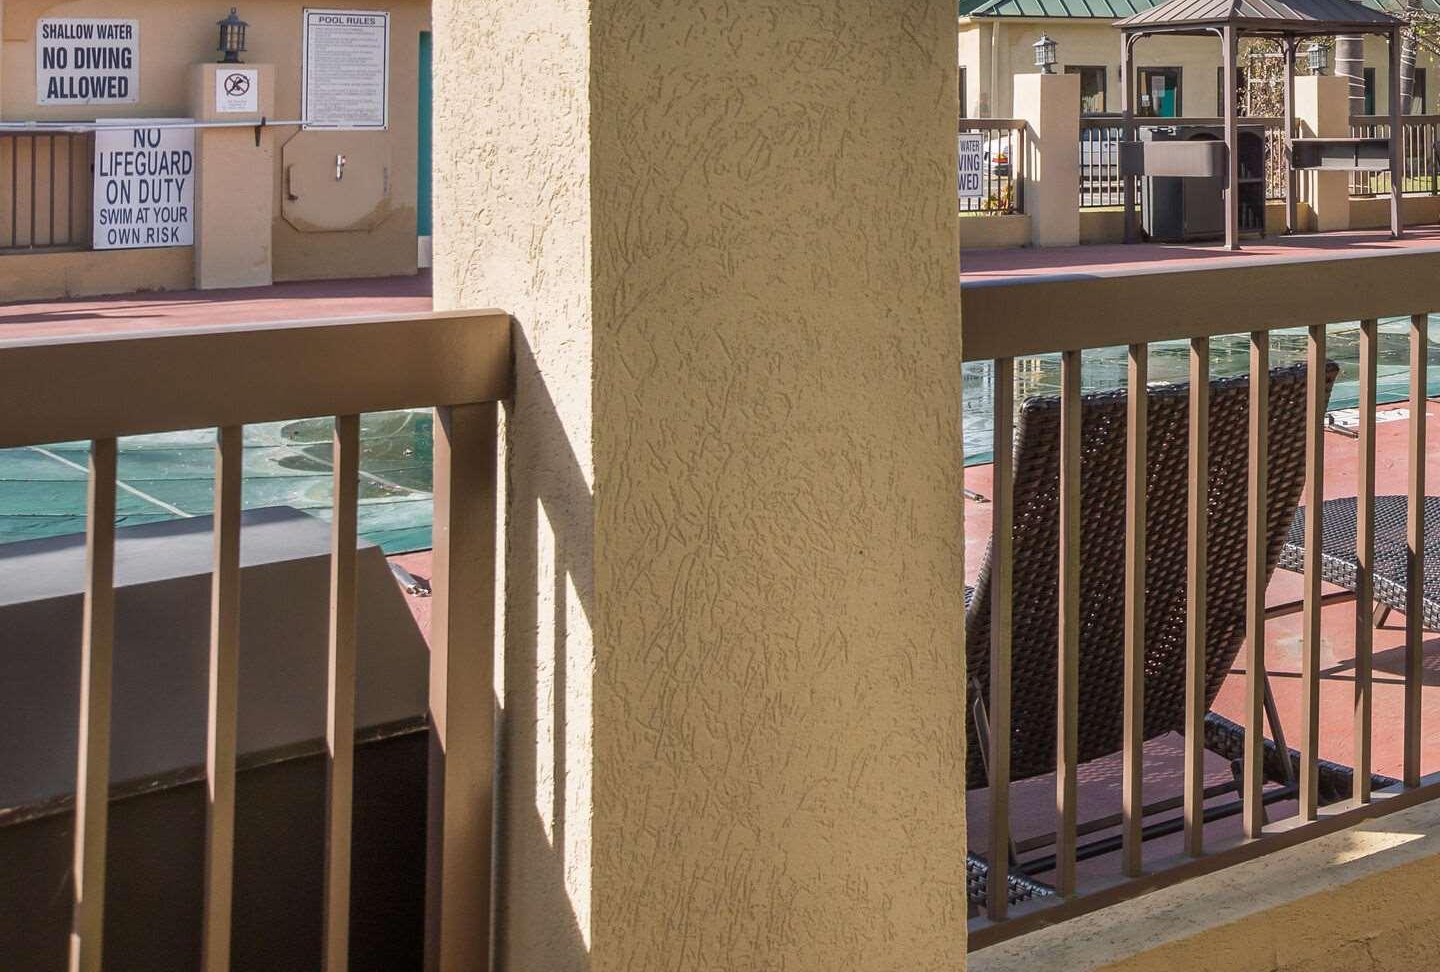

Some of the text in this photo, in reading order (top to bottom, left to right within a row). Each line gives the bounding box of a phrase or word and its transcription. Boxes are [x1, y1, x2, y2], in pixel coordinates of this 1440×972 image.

[319, 16, 376, 25] POOL RULES
[42, 24, 132, 39] SHALLOW WATER
[42, 47, 132, 69] NO DIVING
[47, 76, 129, 99] ALLOWED
[133, 128, 161, 148] NO
[99, 150, 193, 177] LIFEGUARD
[106, 178, 185, 205] ON DUTY
[99, 206, 188, 225] SWIM AT YOUR
[107, 226, 180, 245] OWN RISK
